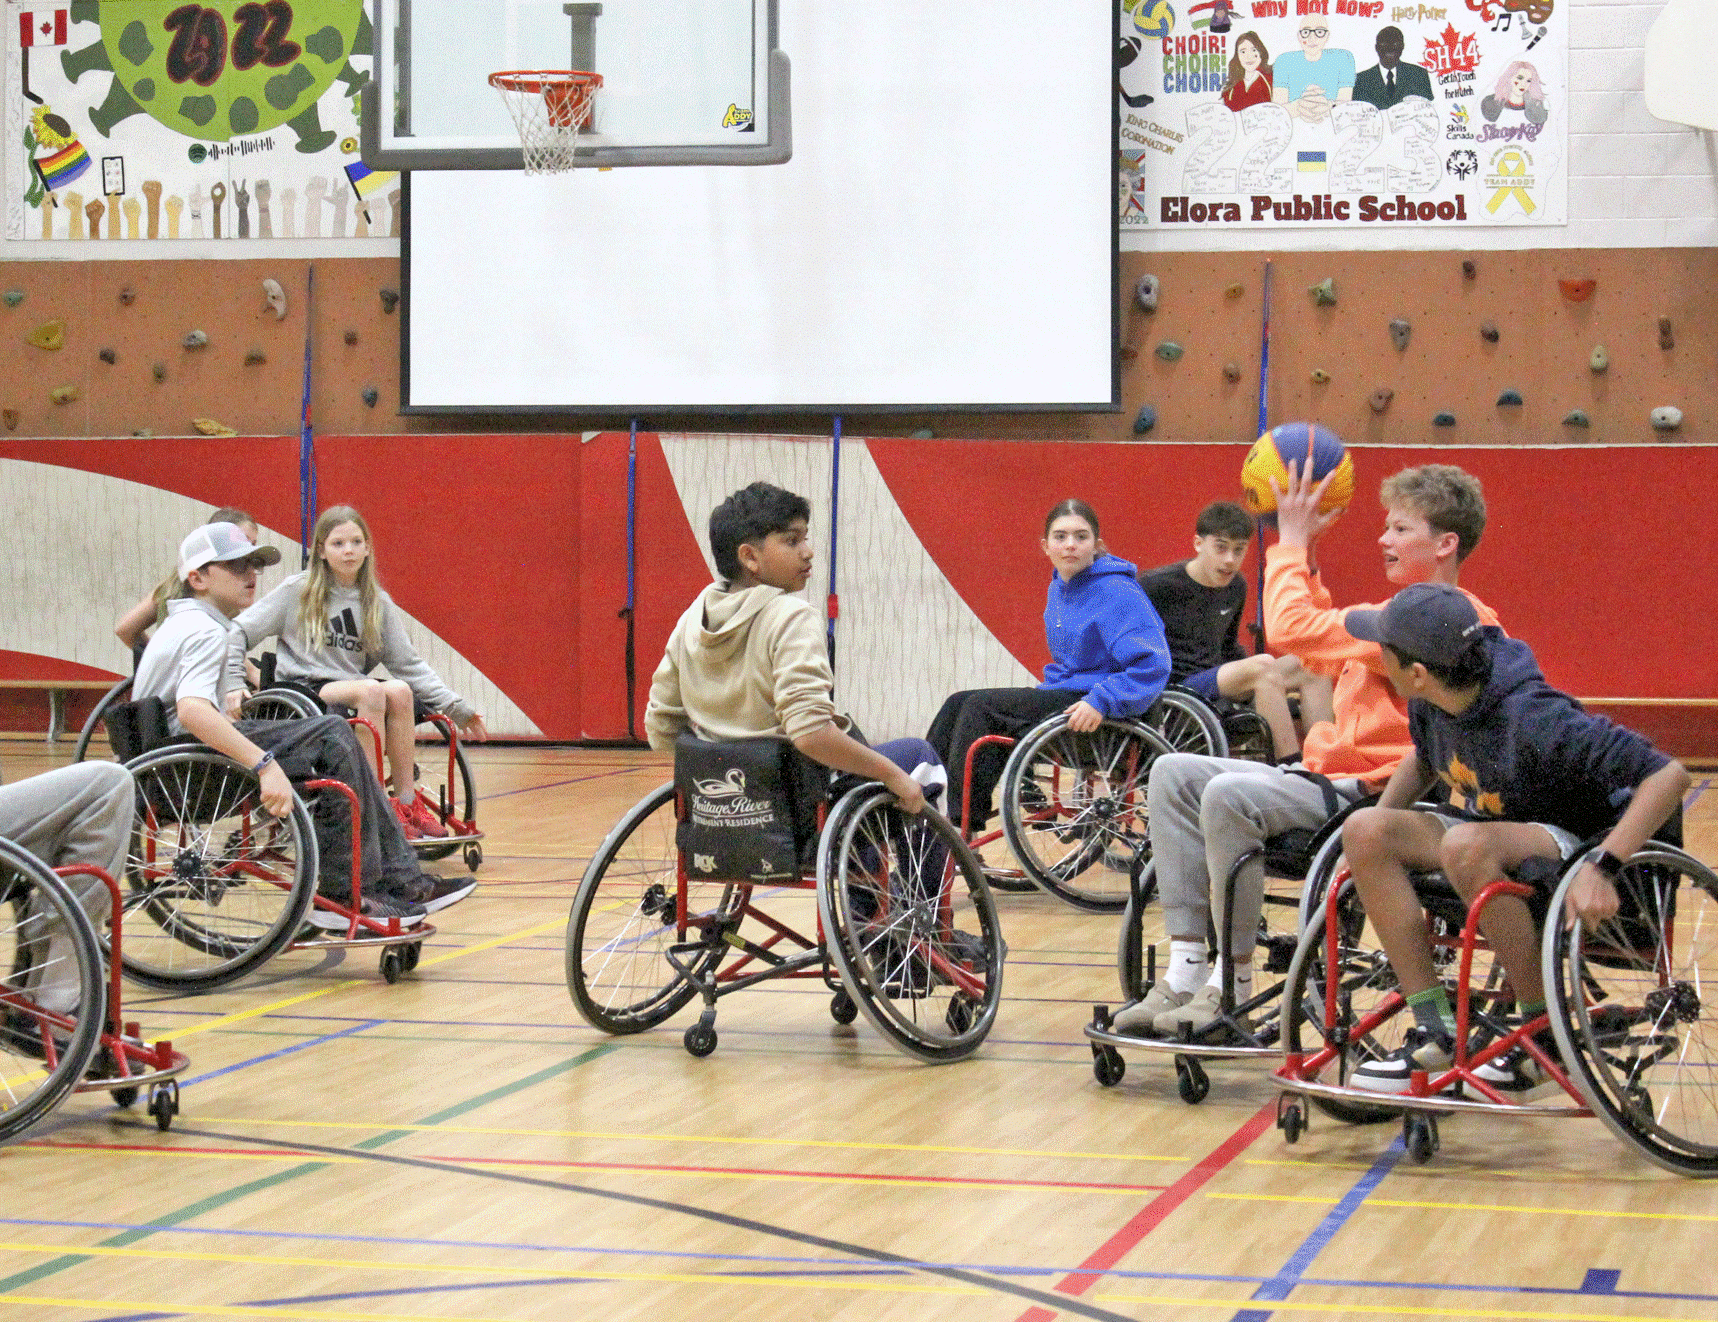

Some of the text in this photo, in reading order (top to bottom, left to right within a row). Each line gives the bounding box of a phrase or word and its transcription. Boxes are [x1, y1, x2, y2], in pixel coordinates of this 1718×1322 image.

[1251, 0, 1385, 18] Why Not Now?
[1391, 3, 1448, 23] Harry Potter
[1423, 39, 1480, 73] SH44
[1126, 113, 1148, 129] KING
[1446, 124, 1467, 133] Skills
[1446, 131, 1475, 140] Canada
[1160, 194, 1467, 223] Elora Public School
[315, 631, 364, 652] didas
